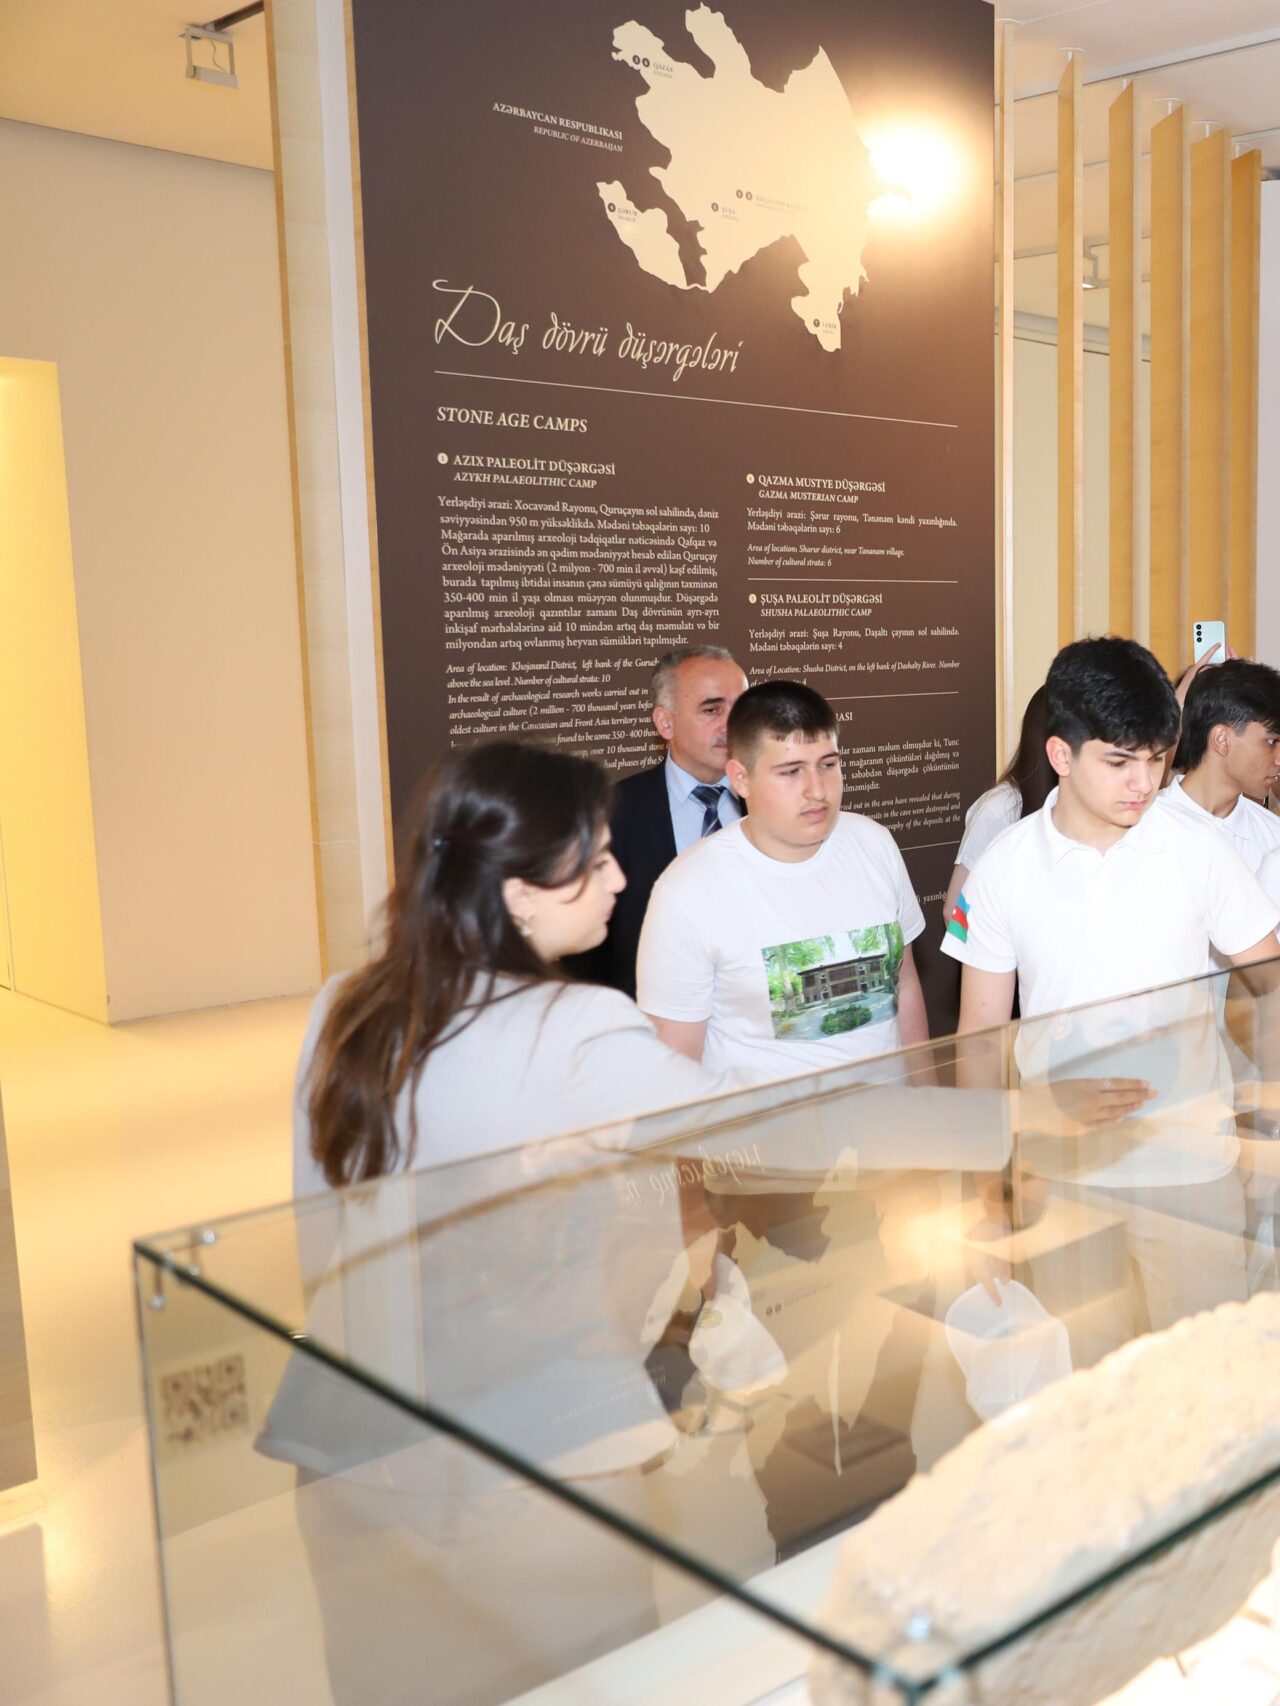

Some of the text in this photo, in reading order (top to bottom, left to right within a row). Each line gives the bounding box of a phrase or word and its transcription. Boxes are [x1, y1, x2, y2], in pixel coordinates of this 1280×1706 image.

[436, 406, 587, 433] STONE AGE CAMPS
[452, 454, 615, 475] AZIX PALEOLİT DÜŞƏRGƏSİ
[453, 471, 597, 488] AZYKH PALAEOLITHIC CAMP
[757, 474, 886, 492] QAZMA MUSTYE DÜŞƏRGƏSİ
[757, 489, 859, 503] GAZMA MUSTERIAN CAMP
[760, 592, 883, 606] ŞUŞA PALEOLİT DÜŞƏRGƏSİ
[760, 607, 872, 617] SHUSHA PALAEOLITHIC CAMP
